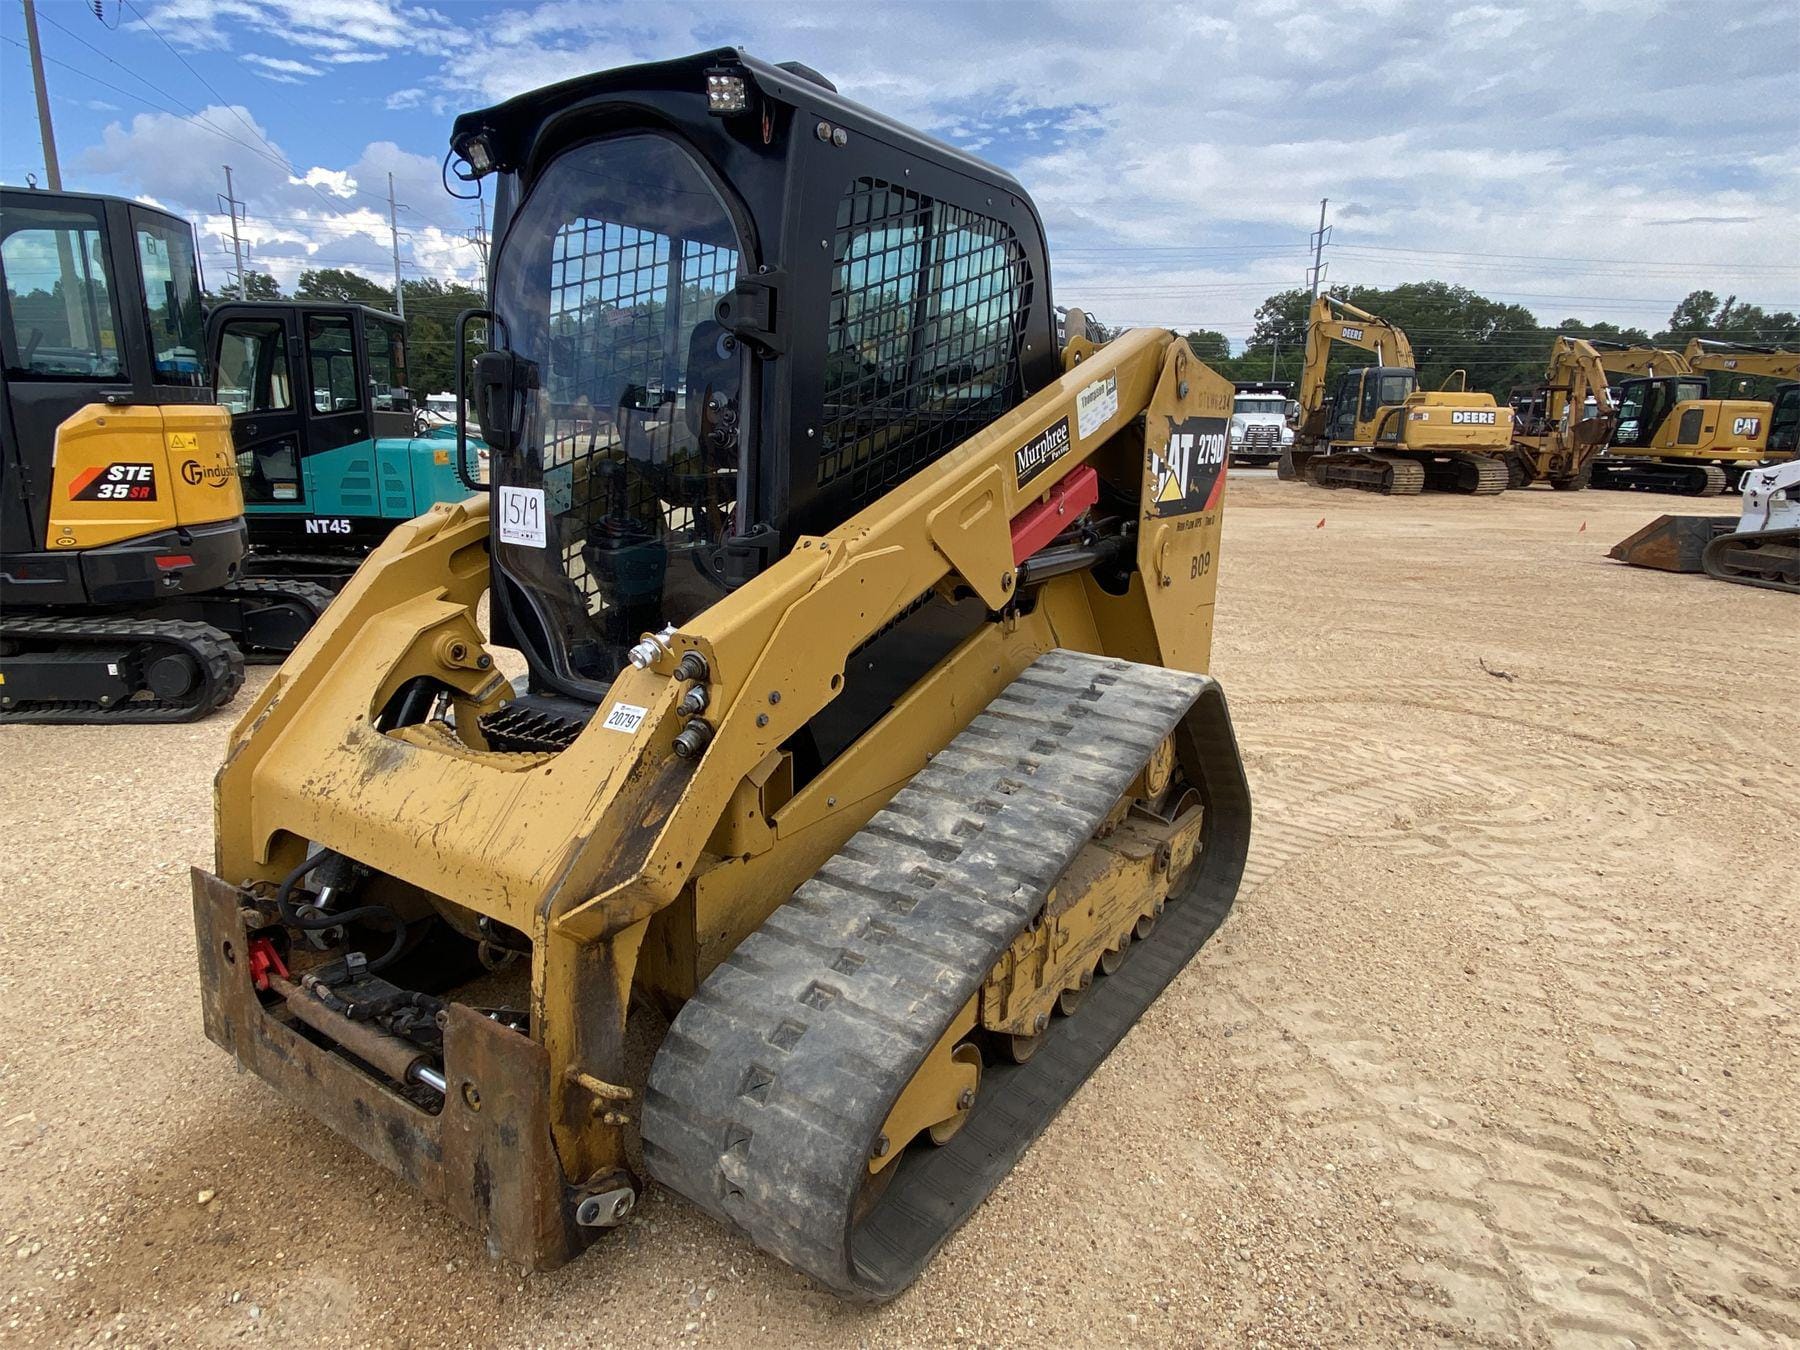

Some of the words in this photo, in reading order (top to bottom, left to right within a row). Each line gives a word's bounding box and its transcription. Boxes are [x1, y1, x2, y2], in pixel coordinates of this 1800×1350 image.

[1341, 327, 1363, 341] DEERE
[1452, 411, 1495, 424] DEERE
[1734, 418, 1759, 435] CAT
[1017, 424, 1067, 474] Murphree
[1197, 434, 1225, 465] 279D
[107, 466, 153, 481] STE
[97, 484, 130, 499] 35
[130, 487, 150, 498] SR
[504, 492, 538, 529] 1519
[305, 519, 351, 534] NT45
[1190, 551, 1211, 580] B09
[608, 711, 641, 729] 20797
